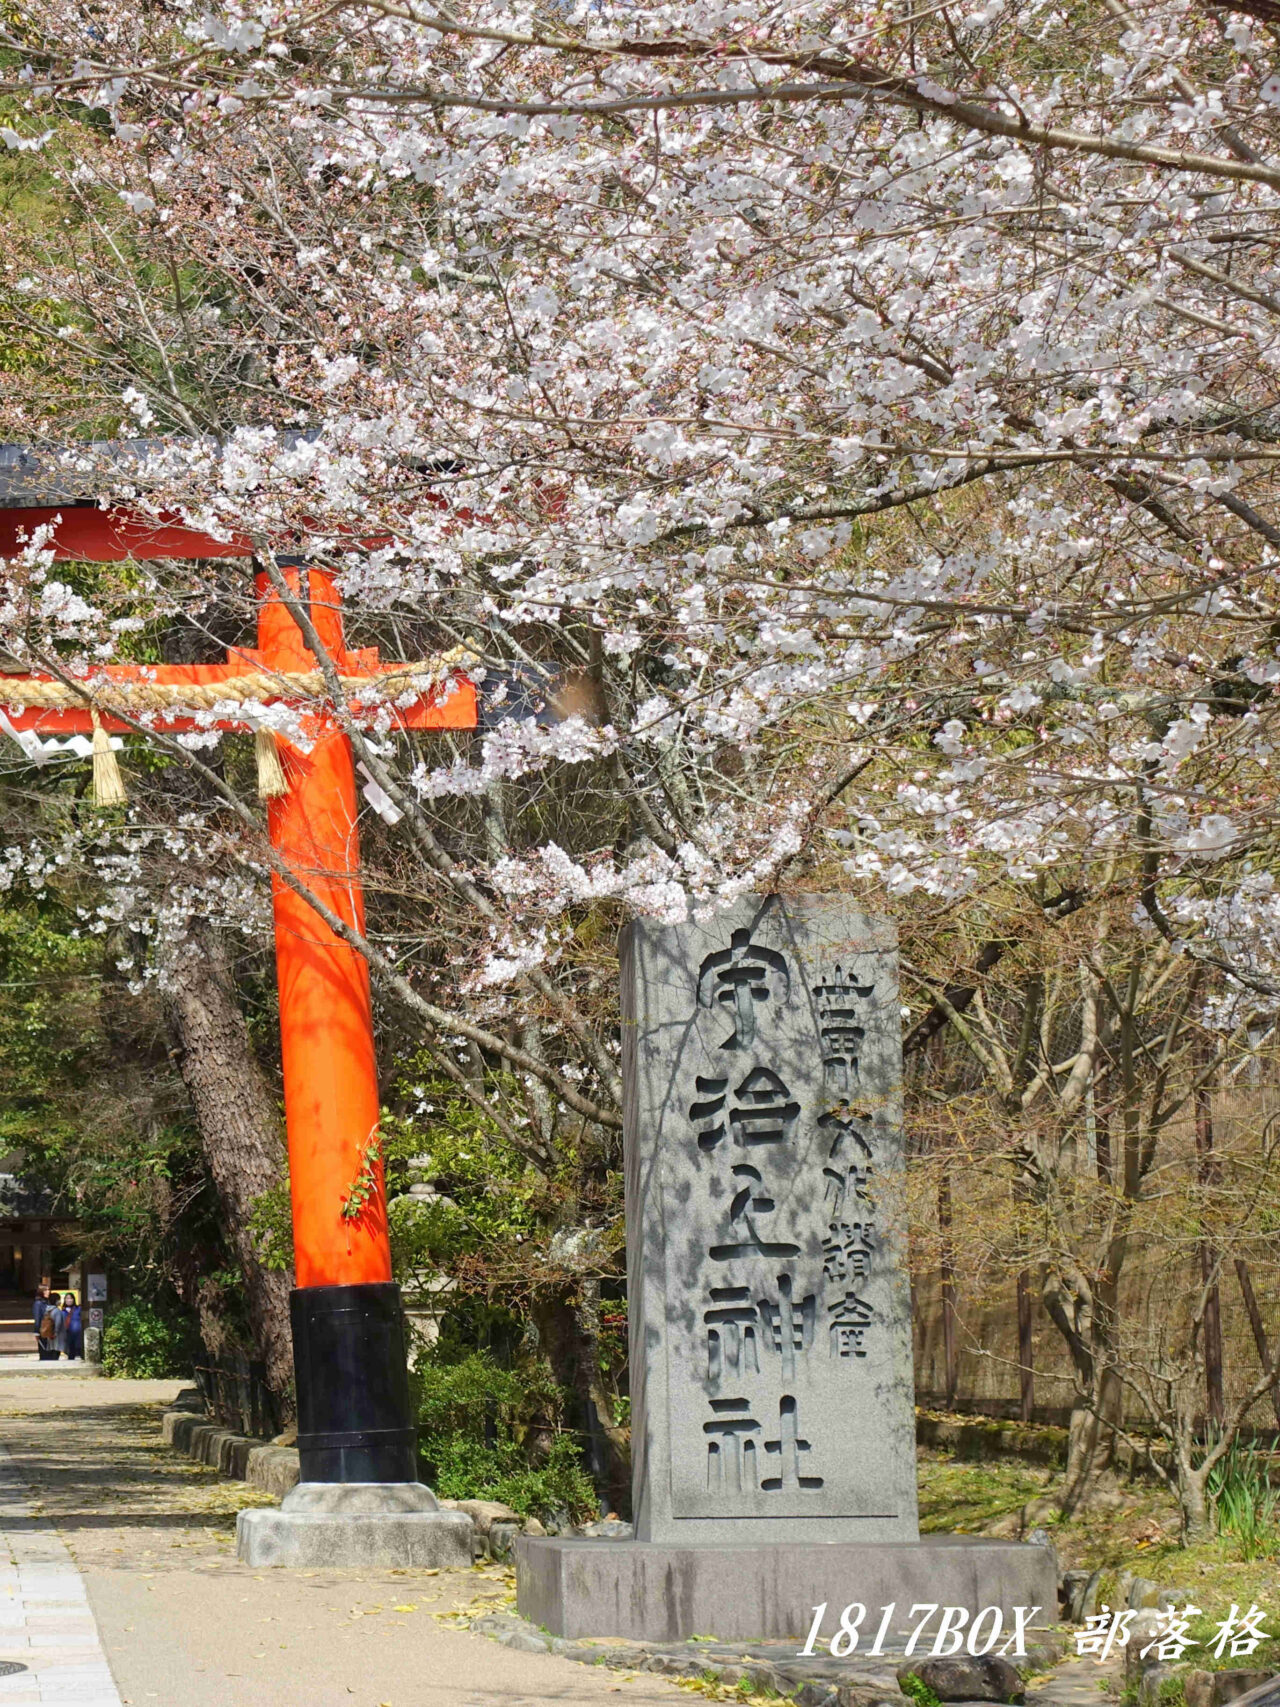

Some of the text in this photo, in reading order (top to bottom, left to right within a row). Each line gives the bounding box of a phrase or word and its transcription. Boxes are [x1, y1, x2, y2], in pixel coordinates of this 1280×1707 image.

[689, 927, 824, 1493] 宇治上神社
